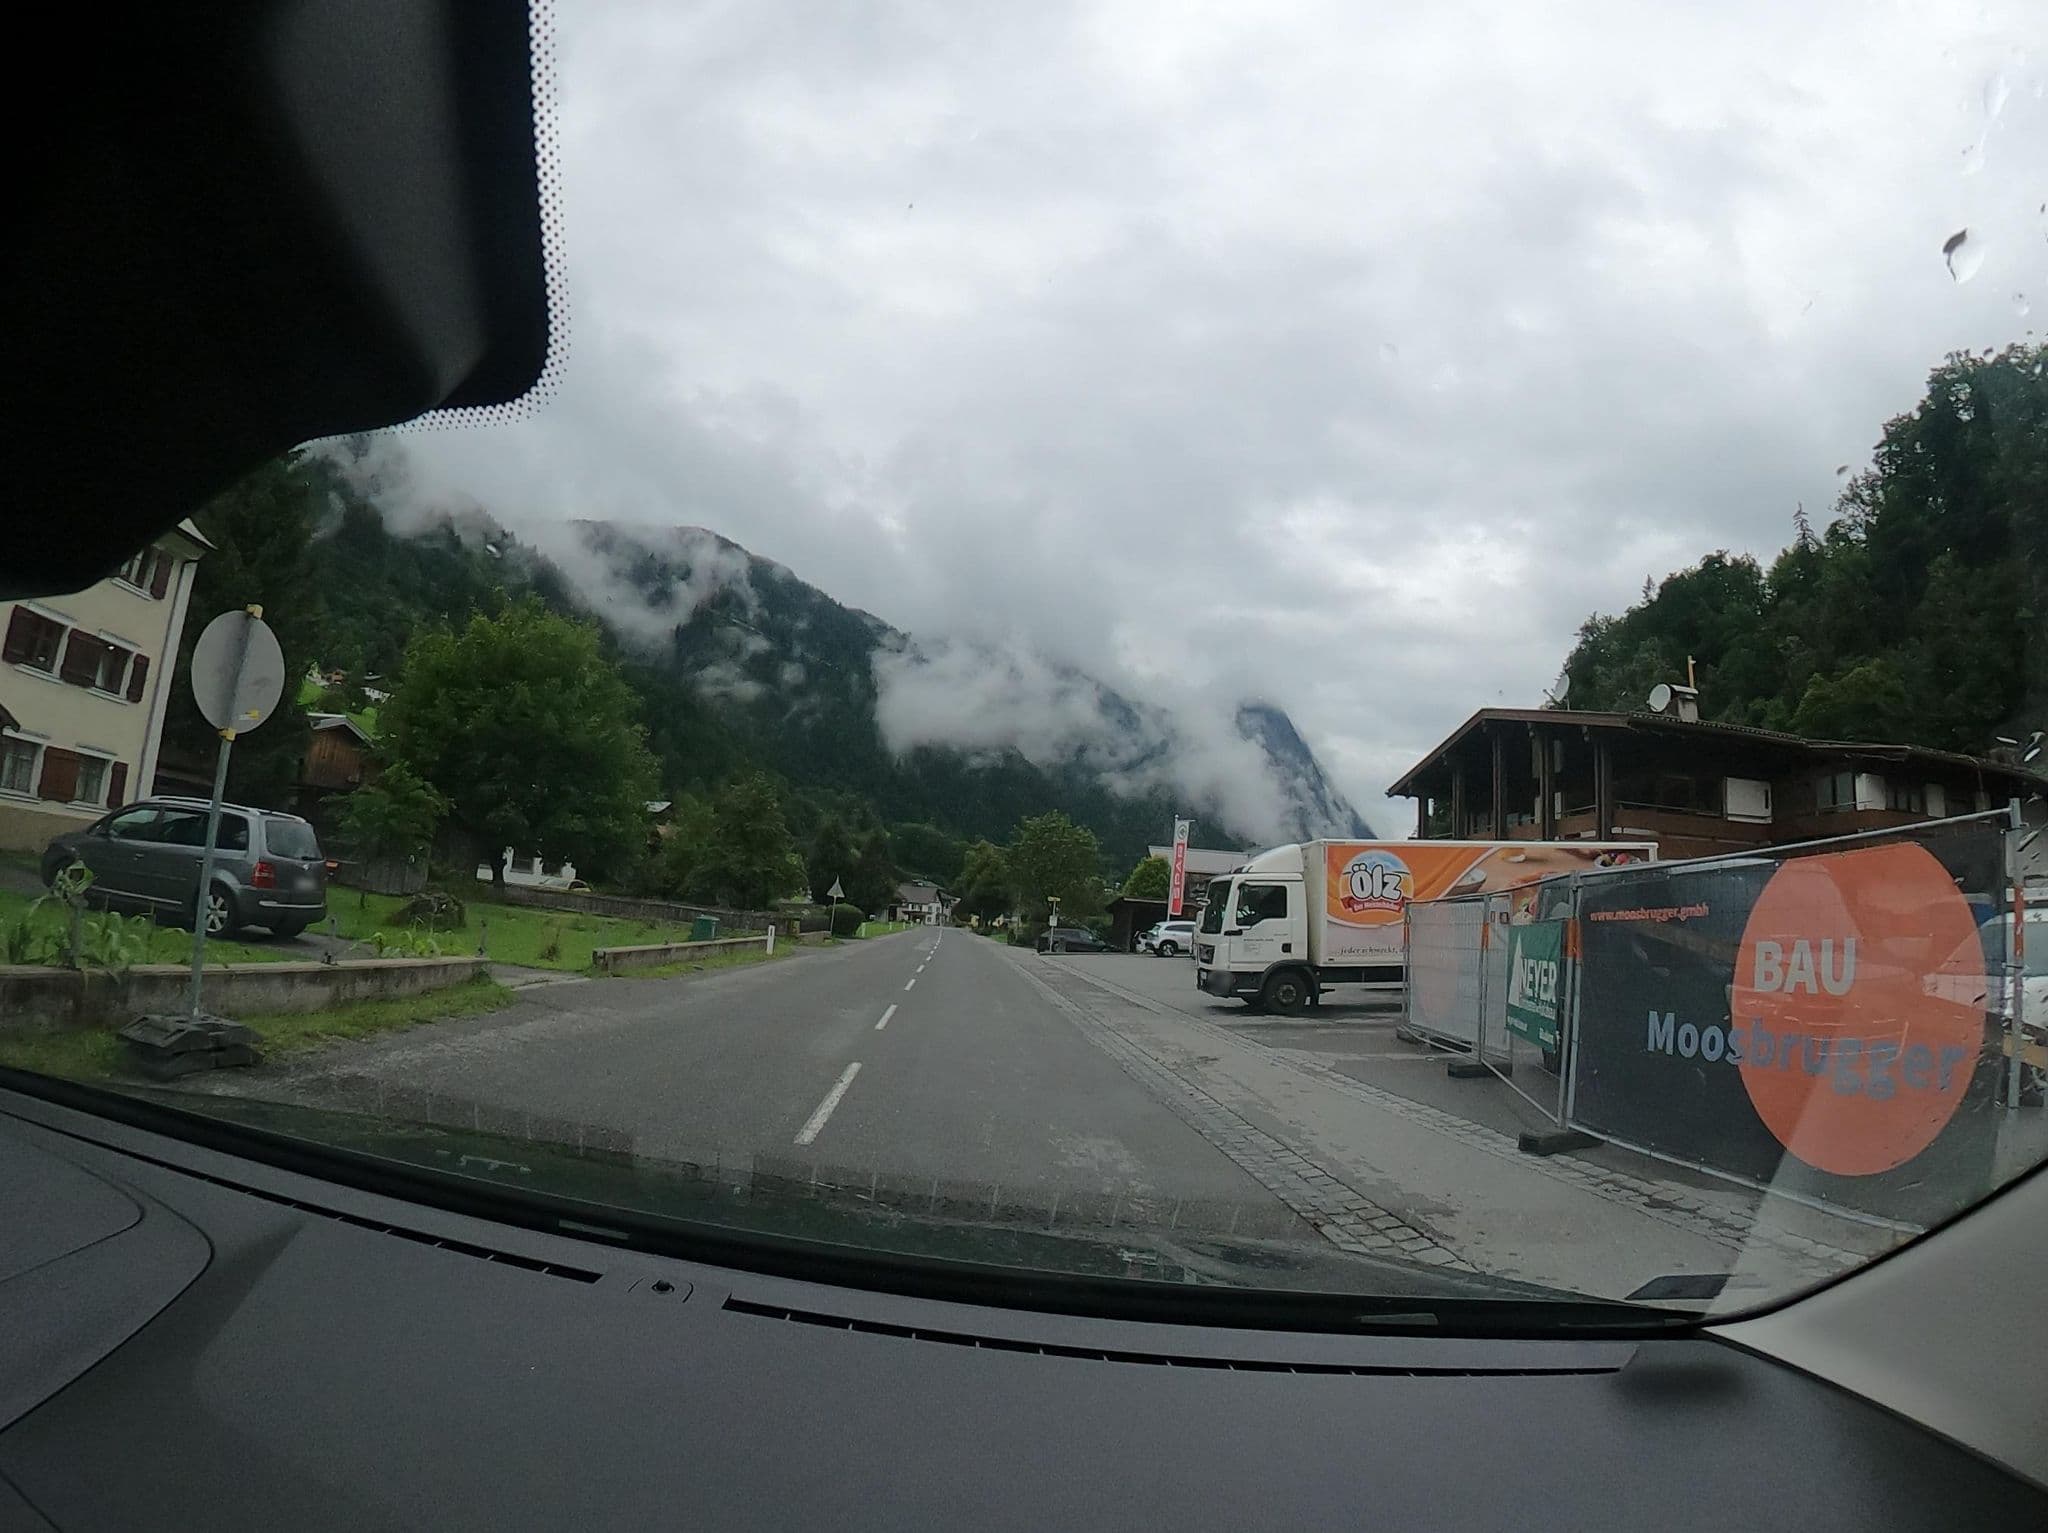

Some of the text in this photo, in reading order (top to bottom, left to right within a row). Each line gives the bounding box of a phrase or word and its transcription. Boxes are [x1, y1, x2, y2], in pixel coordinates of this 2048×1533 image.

[1173, 842, 1185, 899] SPAR
[1350, 862, 1402, 901] Ölz
[1590, 902, 1709, 922] www.moosbrugger.gmbh
[1754, 937, 1857, 997] BAU
[1646, 1009, 1969, 1100] Moosbrugger
